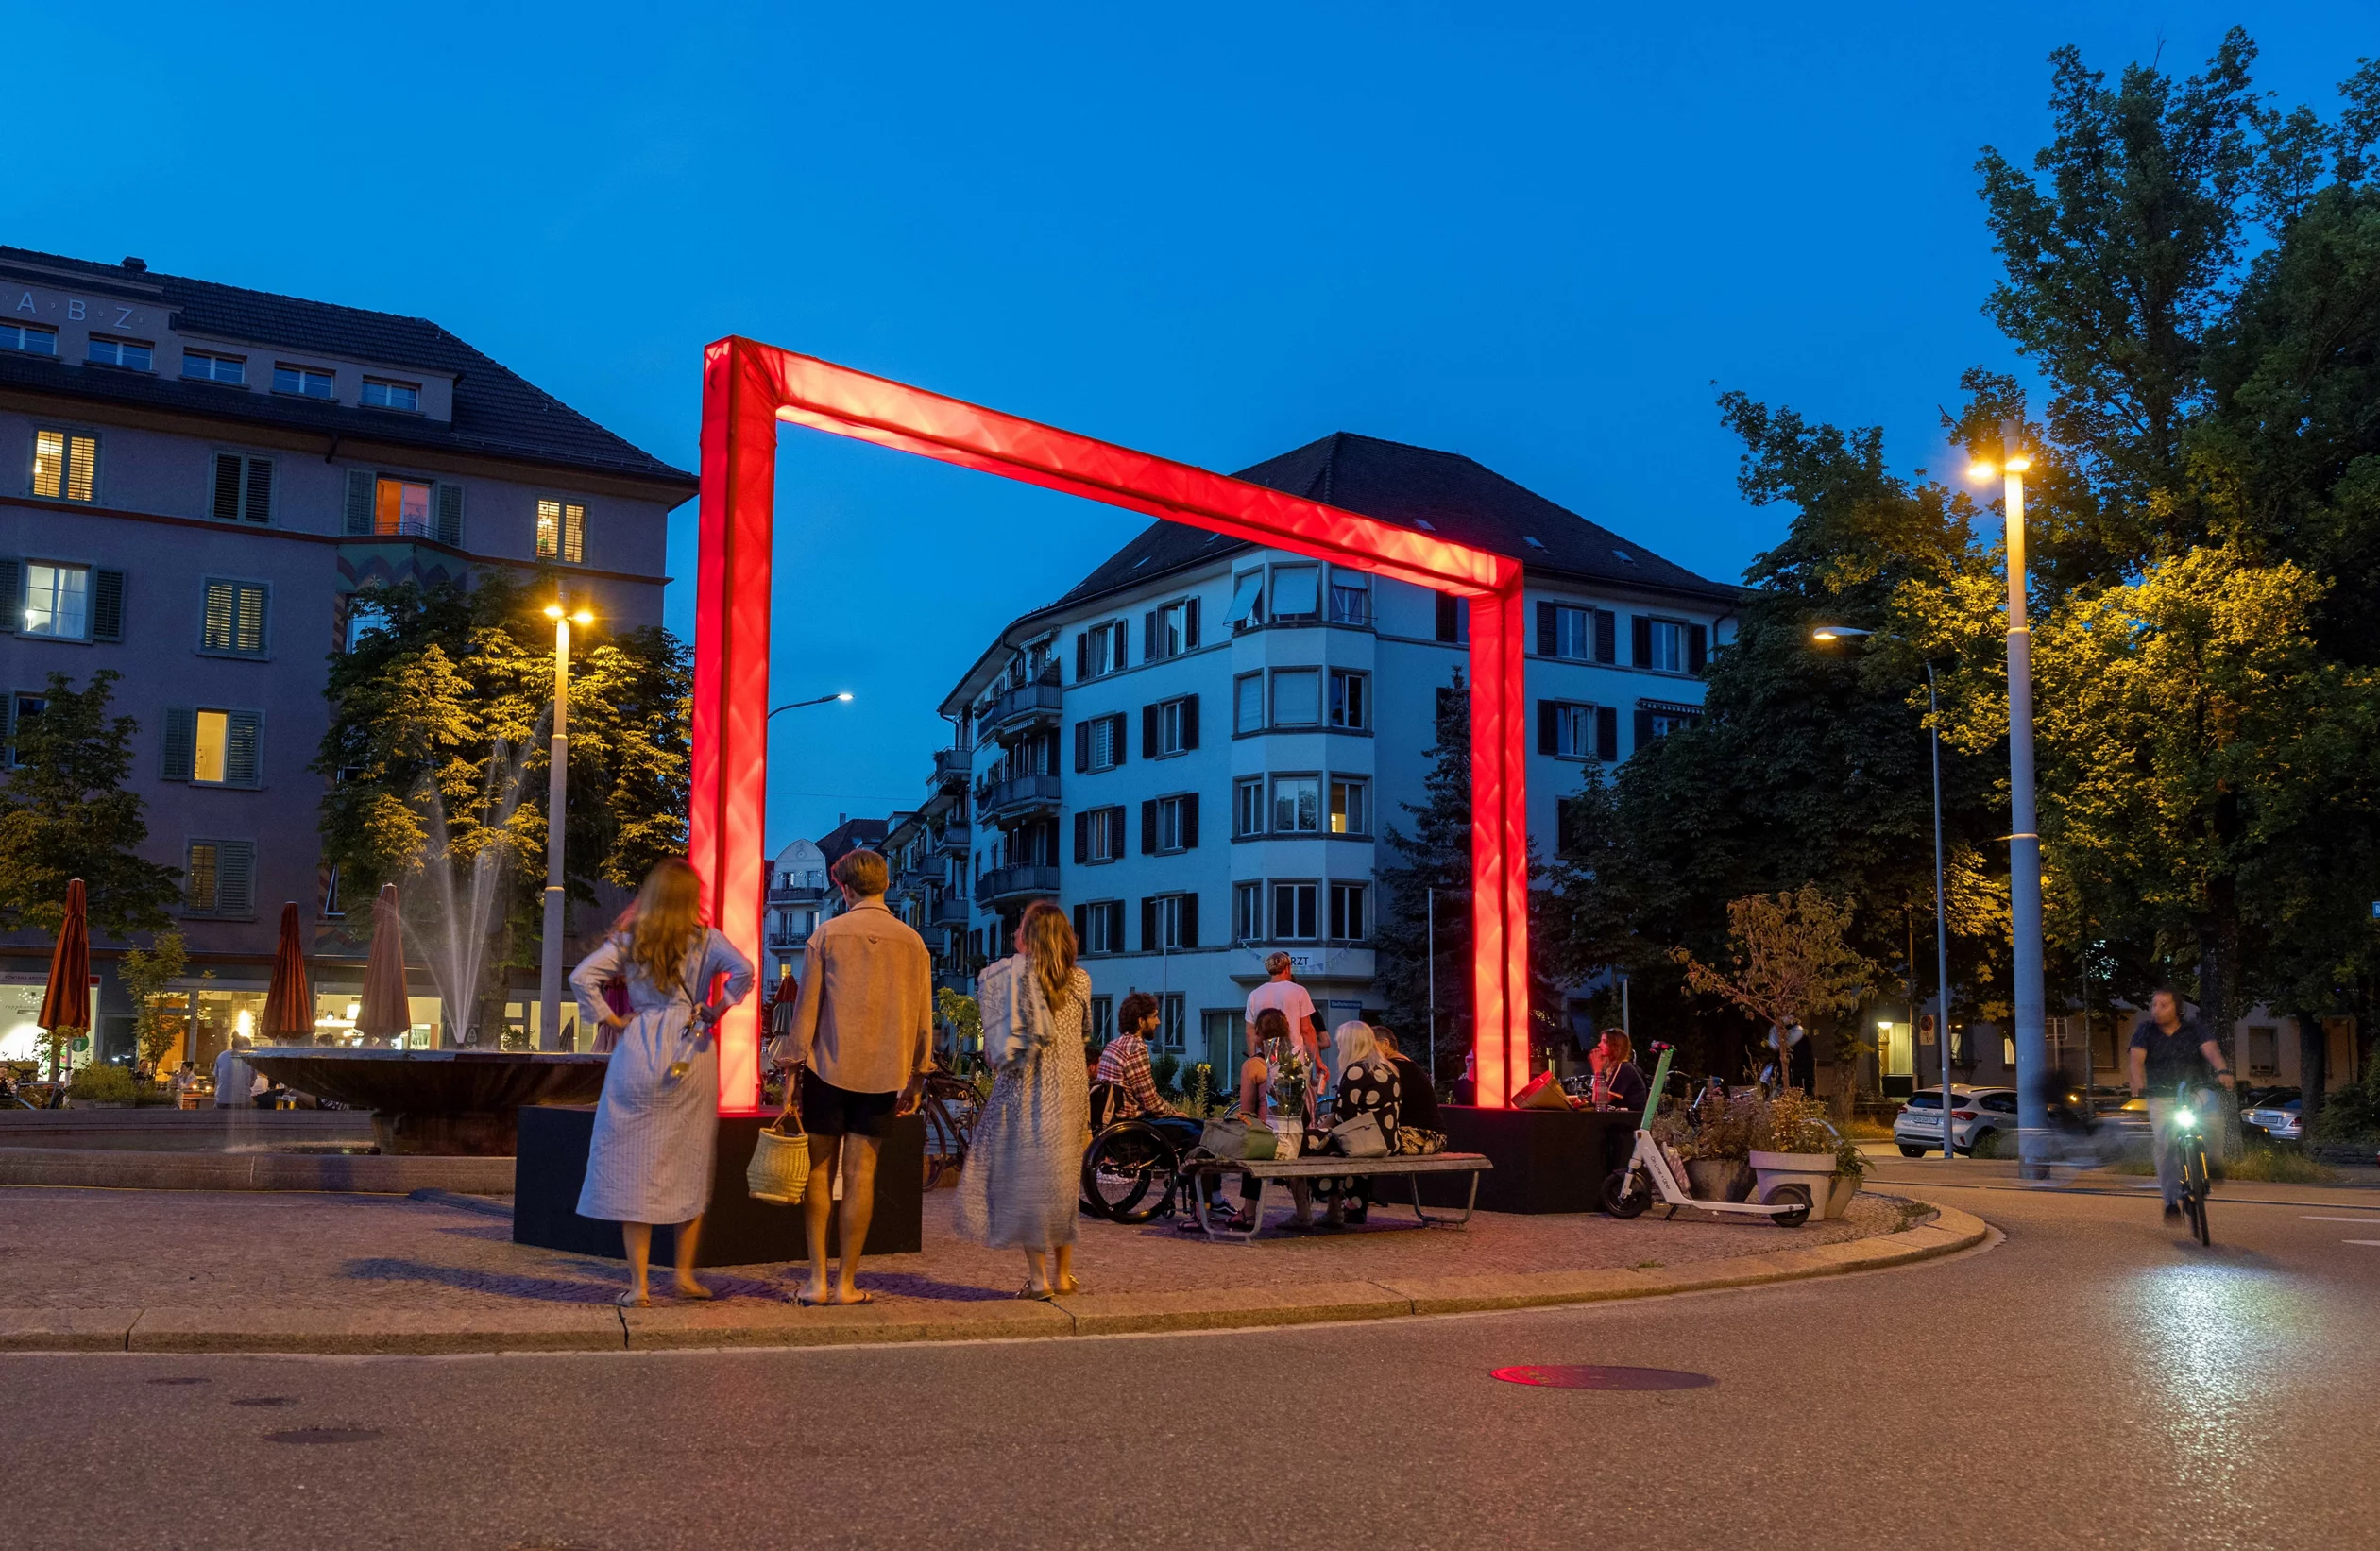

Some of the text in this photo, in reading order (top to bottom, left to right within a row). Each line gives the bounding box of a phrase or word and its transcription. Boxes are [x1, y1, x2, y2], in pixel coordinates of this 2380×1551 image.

[16, 291, 37, 315] A
[67, 298, 87, 321] B
[113, 306, 134, 330] Z
[1654, 1163, 1662, 1175] Lime
